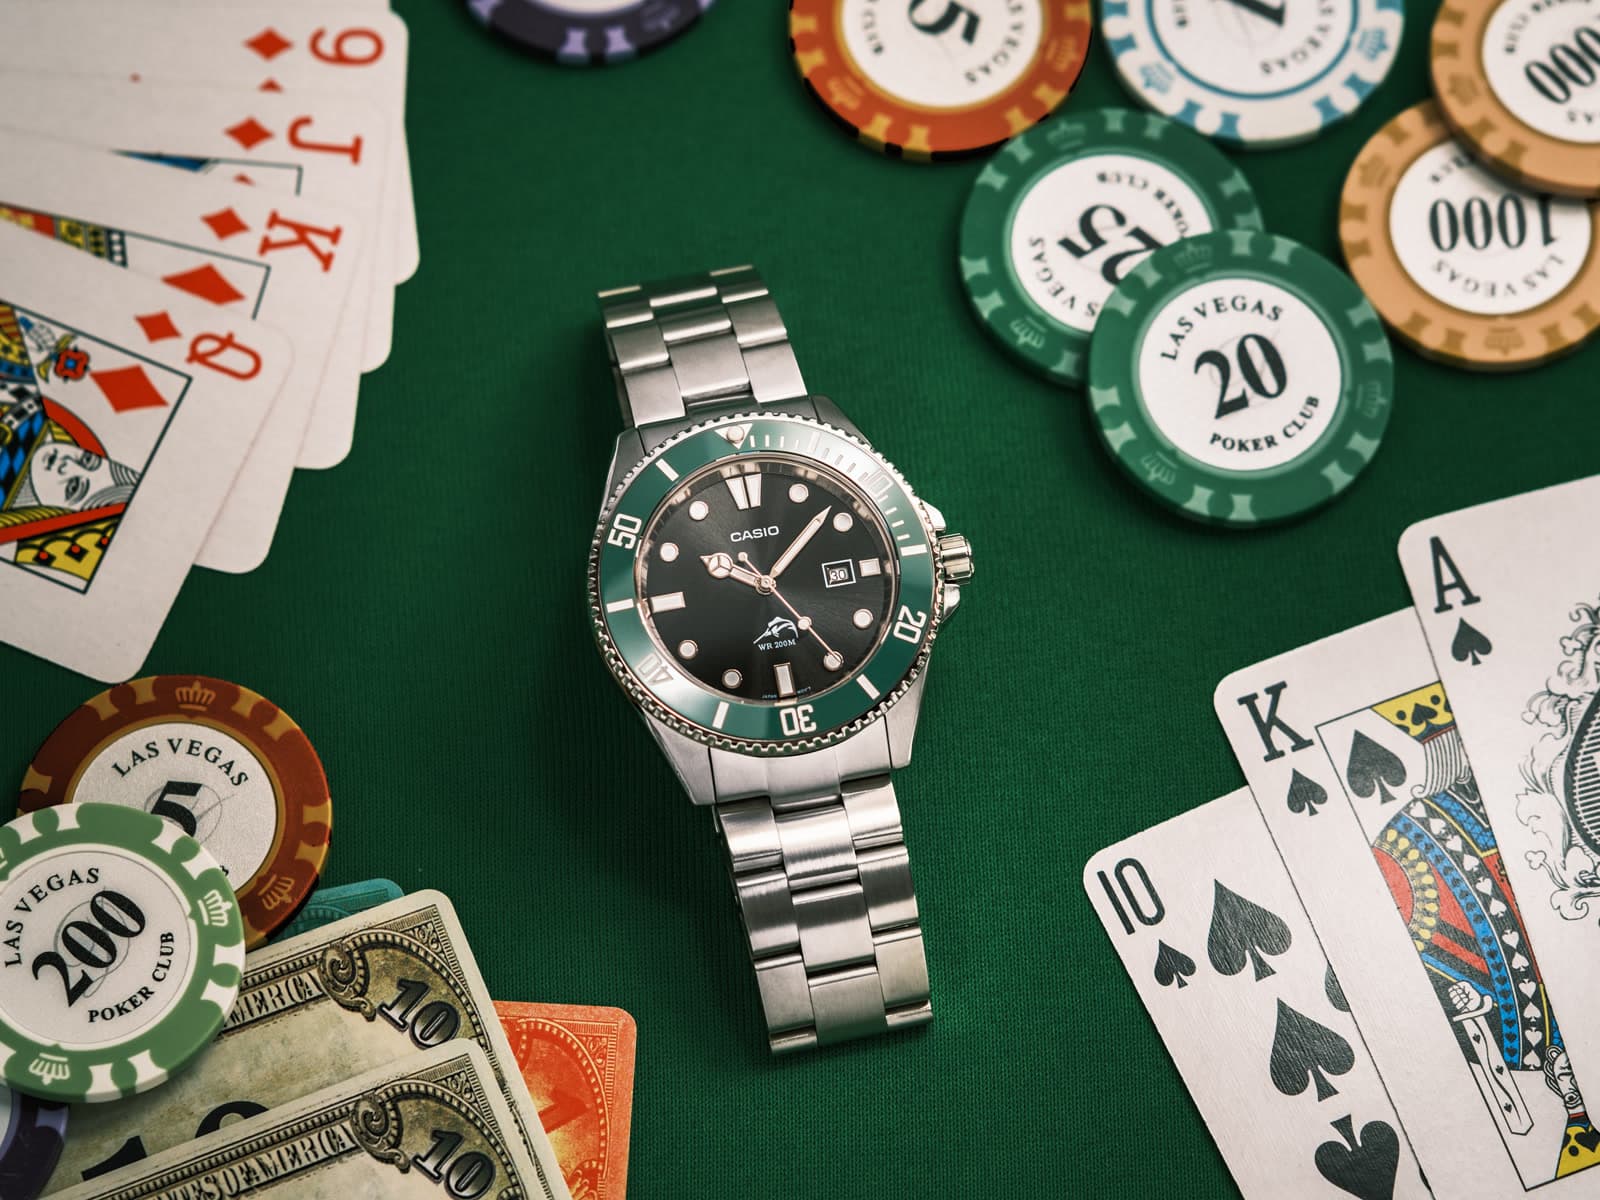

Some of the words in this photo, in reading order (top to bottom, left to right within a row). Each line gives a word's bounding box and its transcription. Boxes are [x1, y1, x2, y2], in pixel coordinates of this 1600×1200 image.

[308, 27, 385, 67] 9
[1523, 25, 1600, 105] 000
[287, 115, 362, 165] J
[259, 209, 342, 273] K
[1058, 203, 1164, 285] 25
[1429, 192, 1558, 252] 1000
[1029, 236, 1077, 310] VEGAS
[1433, 260, 1518, 297] VEGAS
[1522, 253, 1564, 291] LAS
[186, 331, 262, 381] Q
[1160, 316, 1194, 361] LAS
[1193, 295, 1283, 321] VEGAS
[1194, 333, 1287, 420] 20
[1210, 432, 1278, 452] POKER
[1282, 395, 1320, 438] CLUB
[607, 513, 642, 549] 50
[730, 525, 780, 543] CASIO
[830, 568, 848, 581] 30
[1428, 535, 1482, 613] A
[758, 643, 773, 651] WR
[775, 639, 797, 649] 200M
[893, 605, 927, 644] 20
[779, 704, 817, 736] 30
[1237, 681, 1314, 762] K
[112, 740, 160, 777] LAS
[167, 737, 249, 786] VEGAS
[150, 781, 203, 837] 5
[3, 920, 24, 968] LAS
[14, 867, 100, 913] VEGAS
[1096, 857, 1166, 934] 10
[32, 890, 146, 1007] 200
[88, 986, 155, 1023] POKER
[152, 931, 175, 982] CLUB
[222, 969, 325, 1027] MERICA
[377, 976, 461, 1050] 10
[410, 1129, 496, 1200] 10
